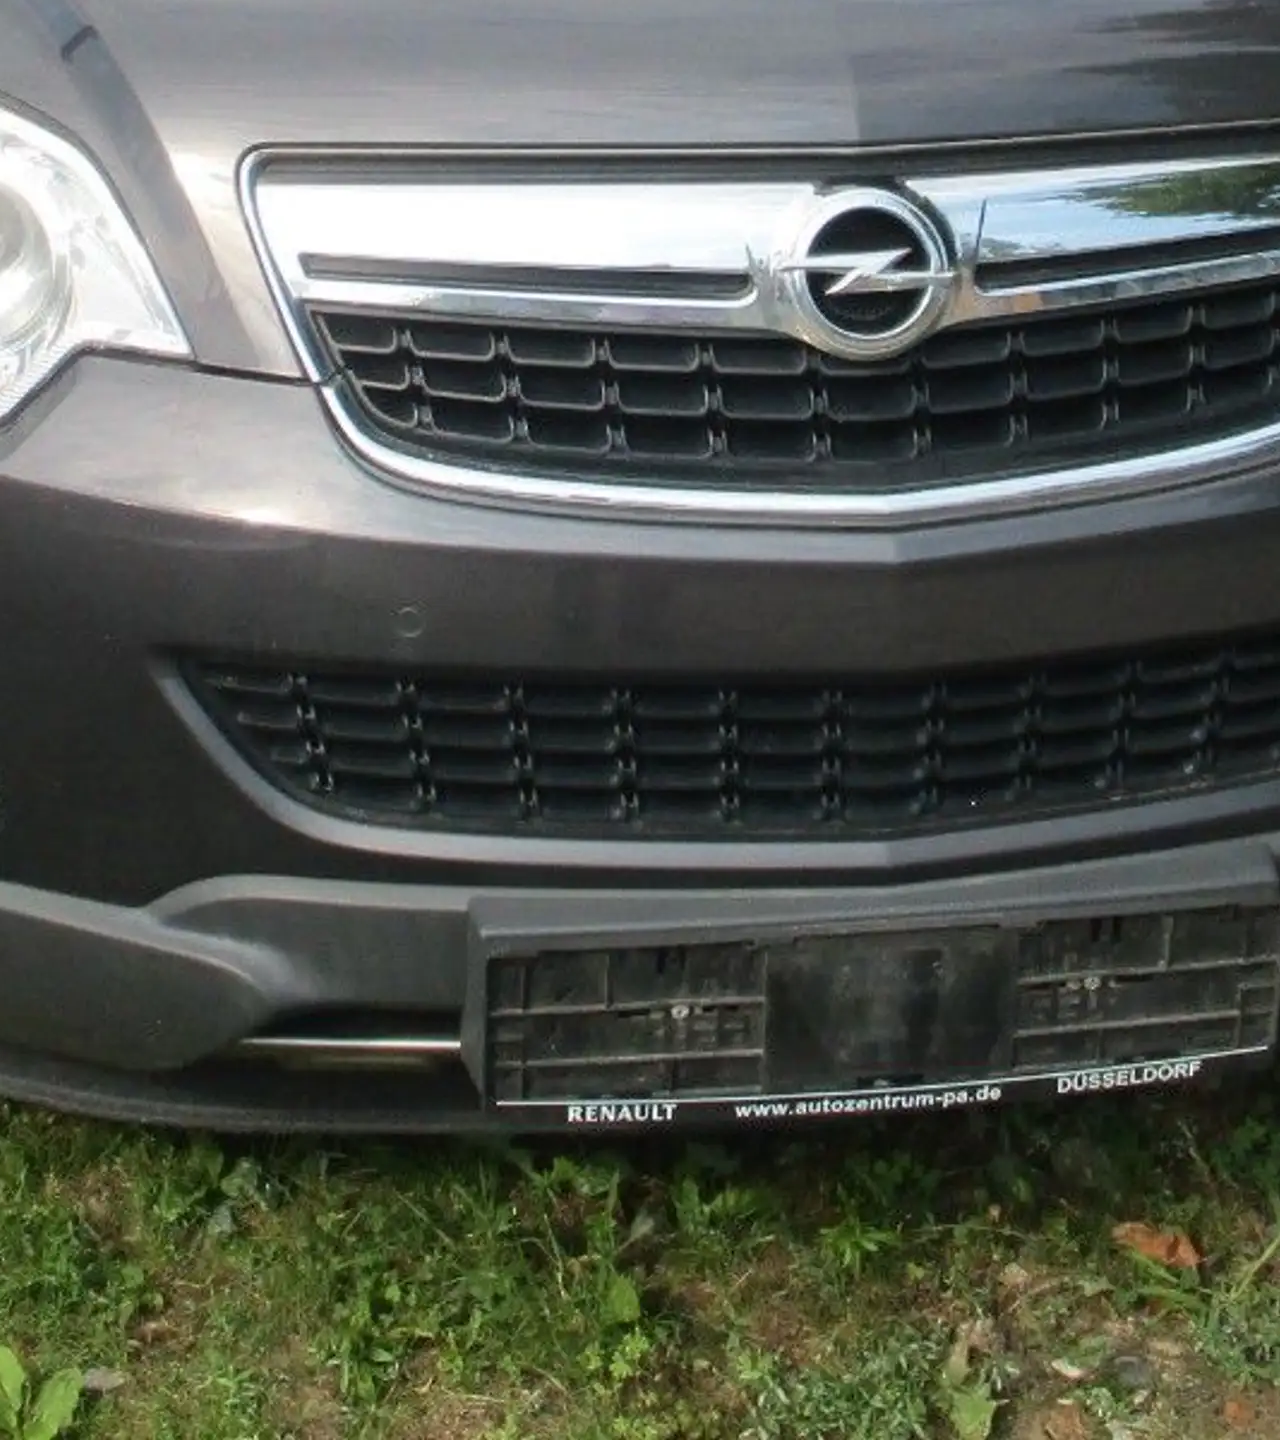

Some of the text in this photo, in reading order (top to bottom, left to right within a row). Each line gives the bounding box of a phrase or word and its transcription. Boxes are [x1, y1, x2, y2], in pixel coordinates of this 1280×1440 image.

[567, 1060, 1202, 1123] RENAULT www.autozentrum-pa.de DÜSSELDORF
